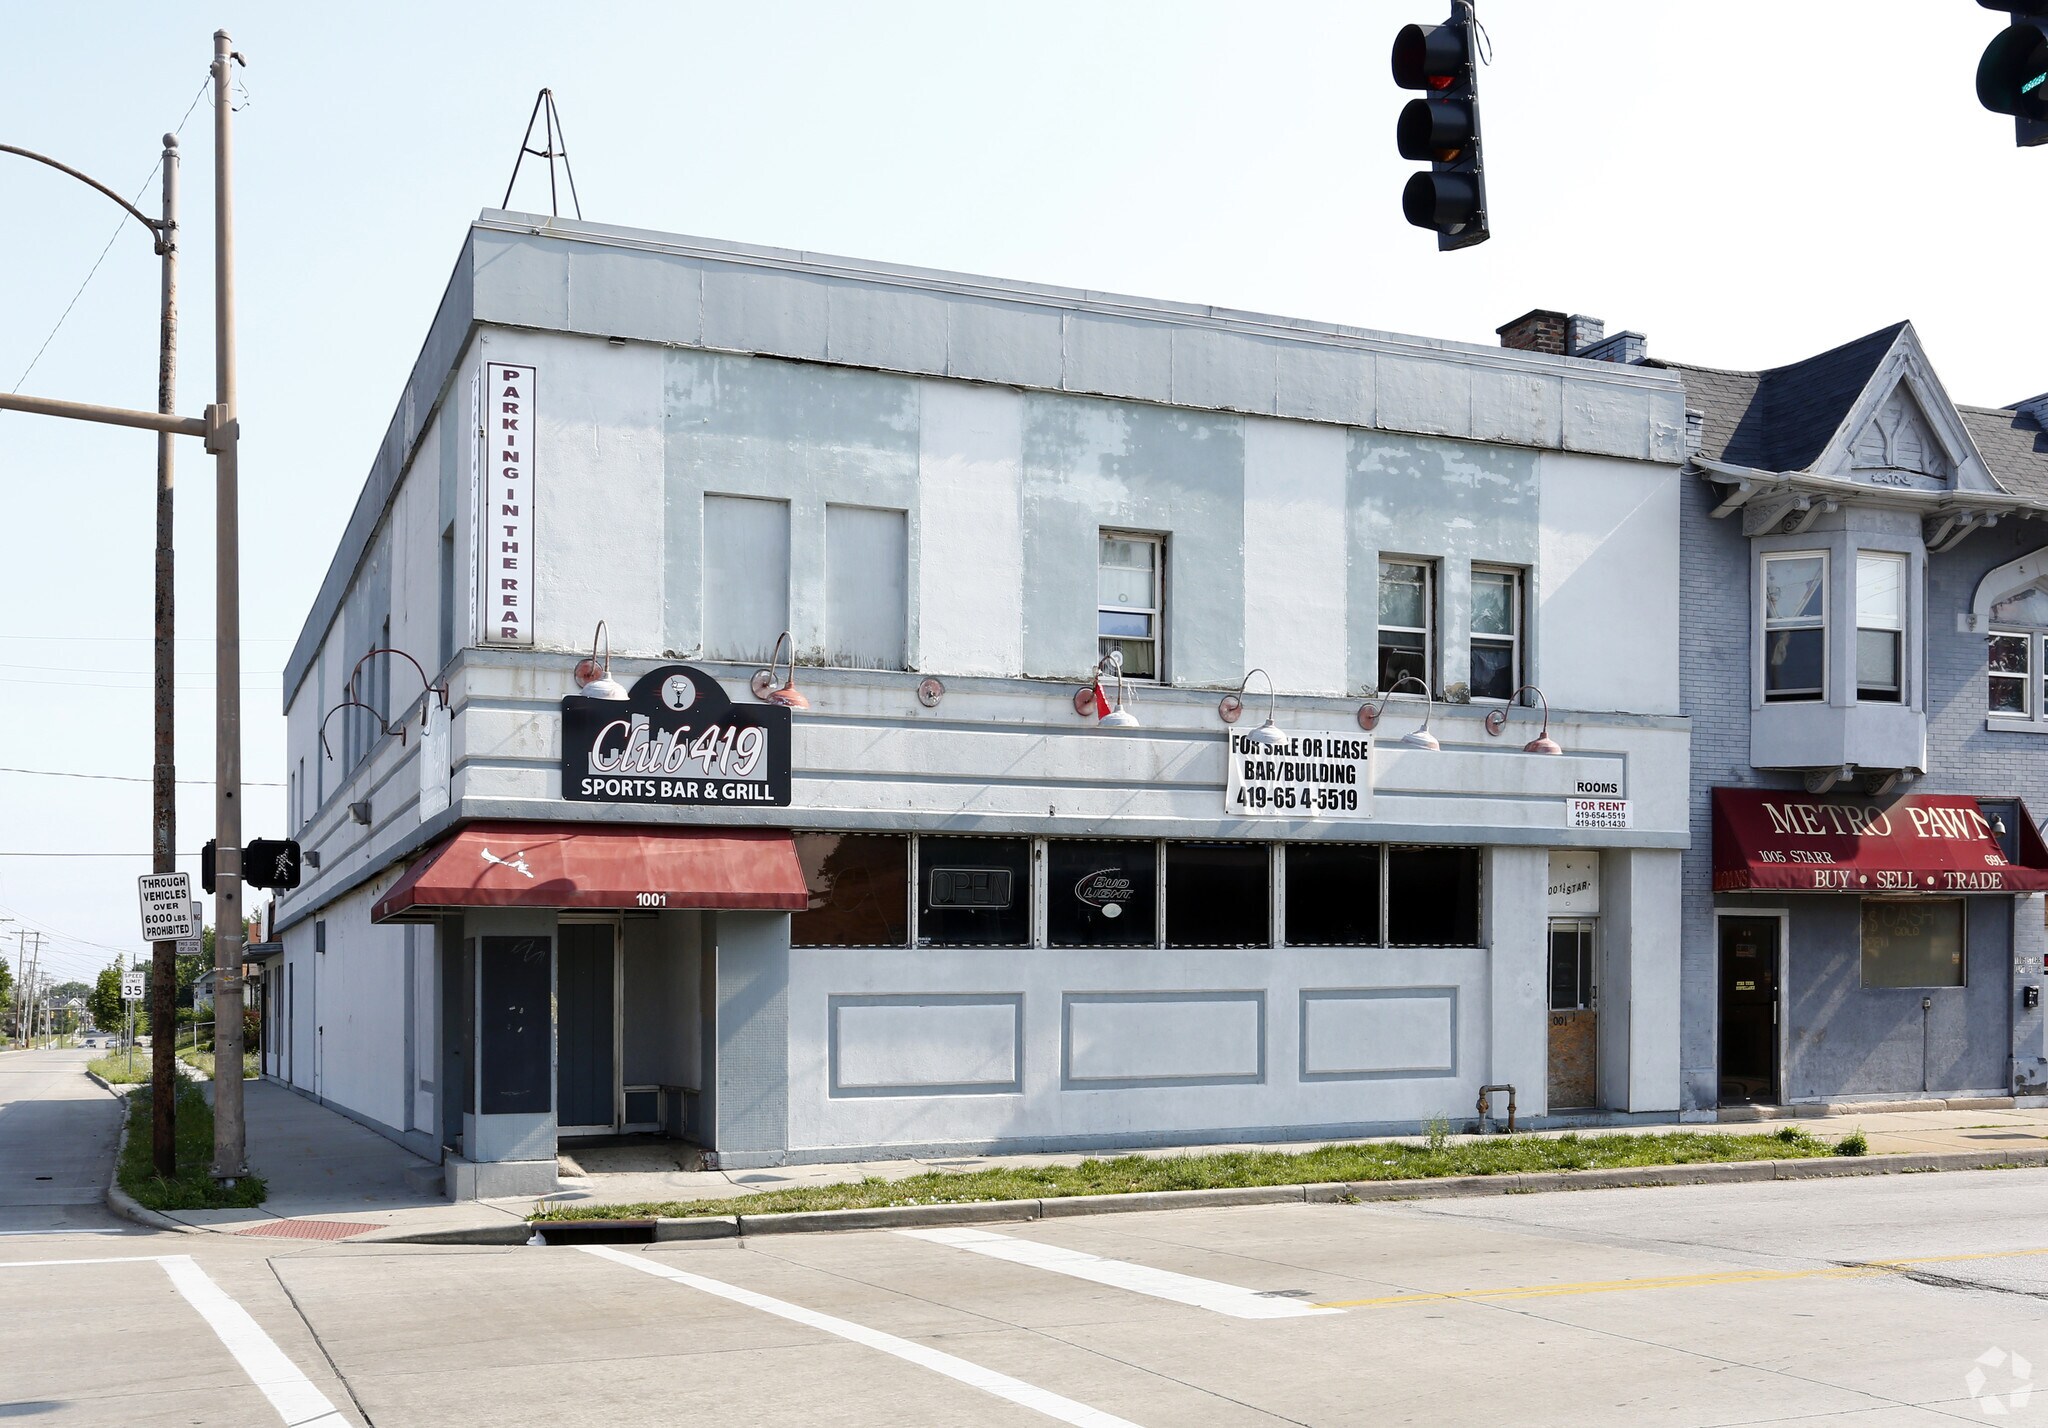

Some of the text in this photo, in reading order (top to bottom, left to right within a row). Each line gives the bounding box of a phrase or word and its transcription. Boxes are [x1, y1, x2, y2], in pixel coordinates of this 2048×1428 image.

[501, 369, 520, 639] PARKING IN THE REAR
[591, 719, 765, 777] Club 419
[1232, 735, 1368, 760] FOR SALE OR LEASE
[1244, 760, 1356, 784] BAR/BUILDING
[581, 778, 775, 800] SPORTS BAR & GRILL
[1577, 782, 1618, 794] ROOMS
[1575, 801, 1626, 811] FOR RENT
[1575, 811, 1626, 820] 419-654-5519
[1762, 802, 1990, 839] METRO PAWN
[1575, 819, 1626, 828] 419-810-1430
[1758, 850, 1836, 864] 1005 STARR
[142, 877, 186, 889] THROUGH
[1093, 876, 1130, 889] BUD
[1814, 870, 2003, 890] BUY SELL TRADE
[935, 872, 1008, 905] OPEN
[1083, 887, 1135, 899] LIGHT
[143, 889, 187, 901] VEHICLES
[636, 892, 666, 907] 1001
[153, 902, 179, 910] OVER
[145, 913, 172, 924] 6000
[173, 914, 188, 922] LBS.
[146, 924, 189, 936] PROHIBITED
[124, 985, 142, 996] 35
